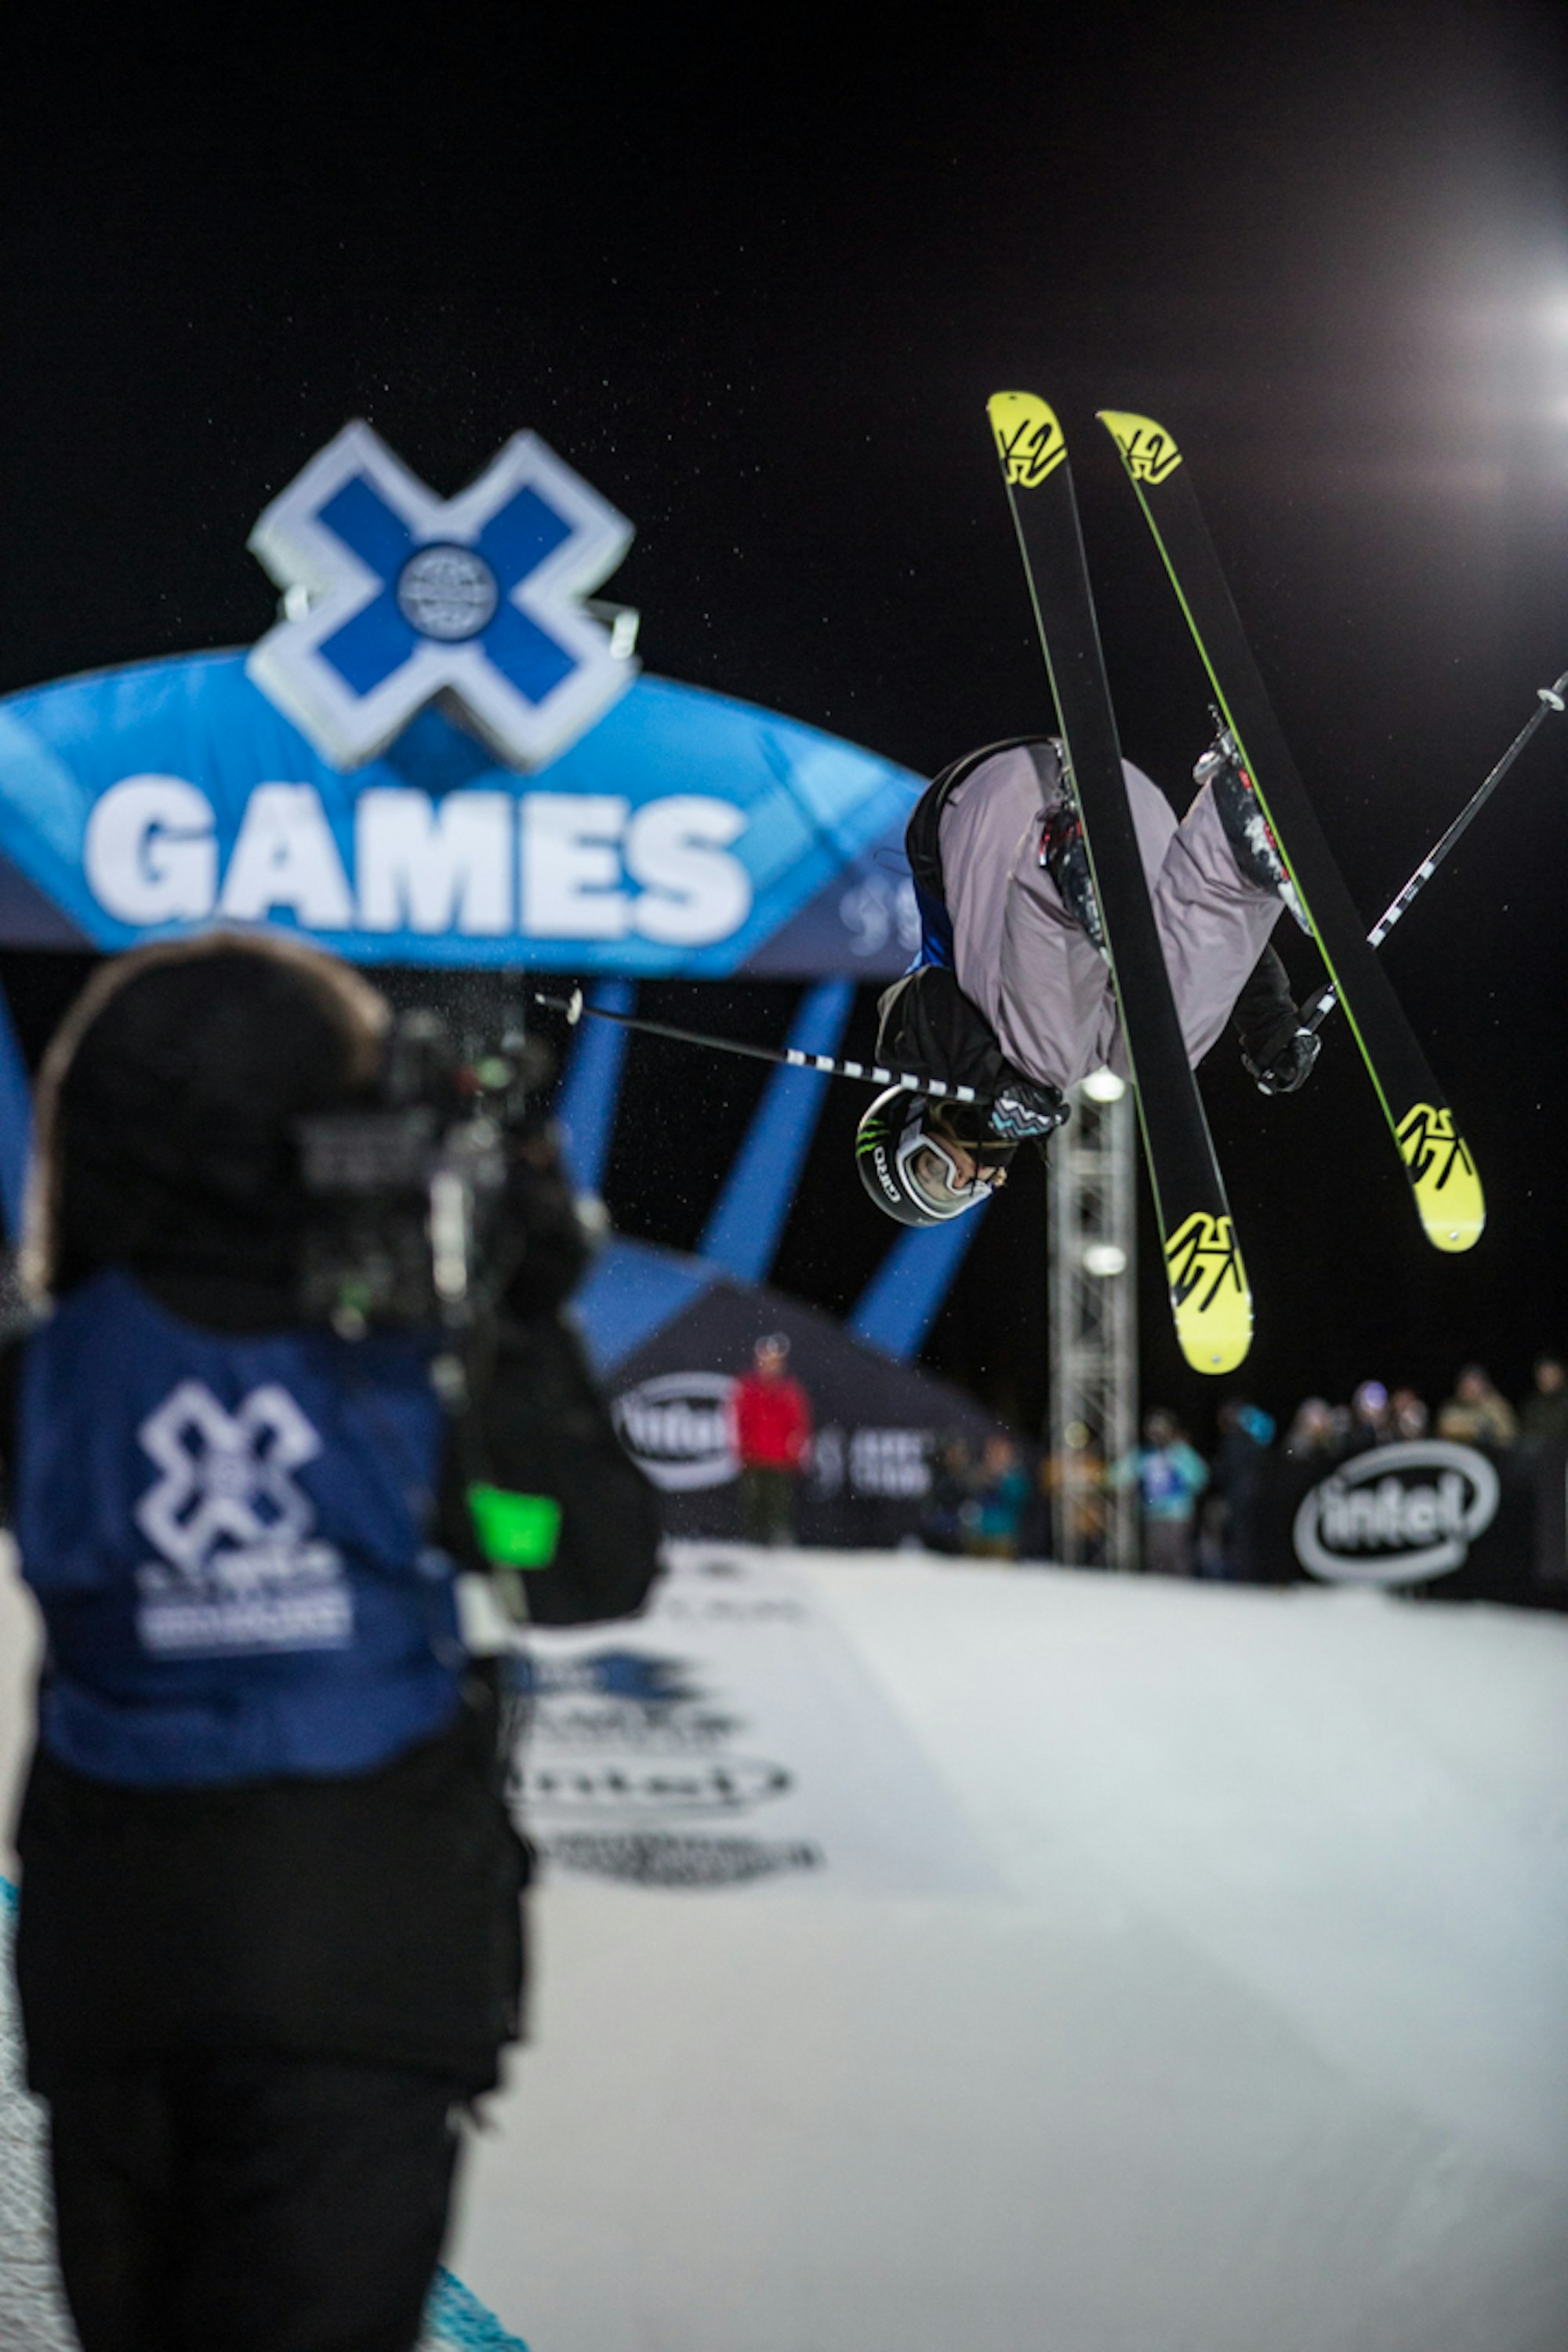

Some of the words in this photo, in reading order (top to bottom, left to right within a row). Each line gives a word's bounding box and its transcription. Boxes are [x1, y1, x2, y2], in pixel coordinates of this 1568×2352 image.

[997, 419, 1068, 488] K2
[1116, 429, 1181, 486] K2
[86, 775, 753, 946] GAMES
[874, 1146, 901, 1202] GIRO
[1399, 1104, 1472, 1190] K2
[1167, 1212, 1242, 1312] K2
[1318, 1472, 1466, 1549] intel
